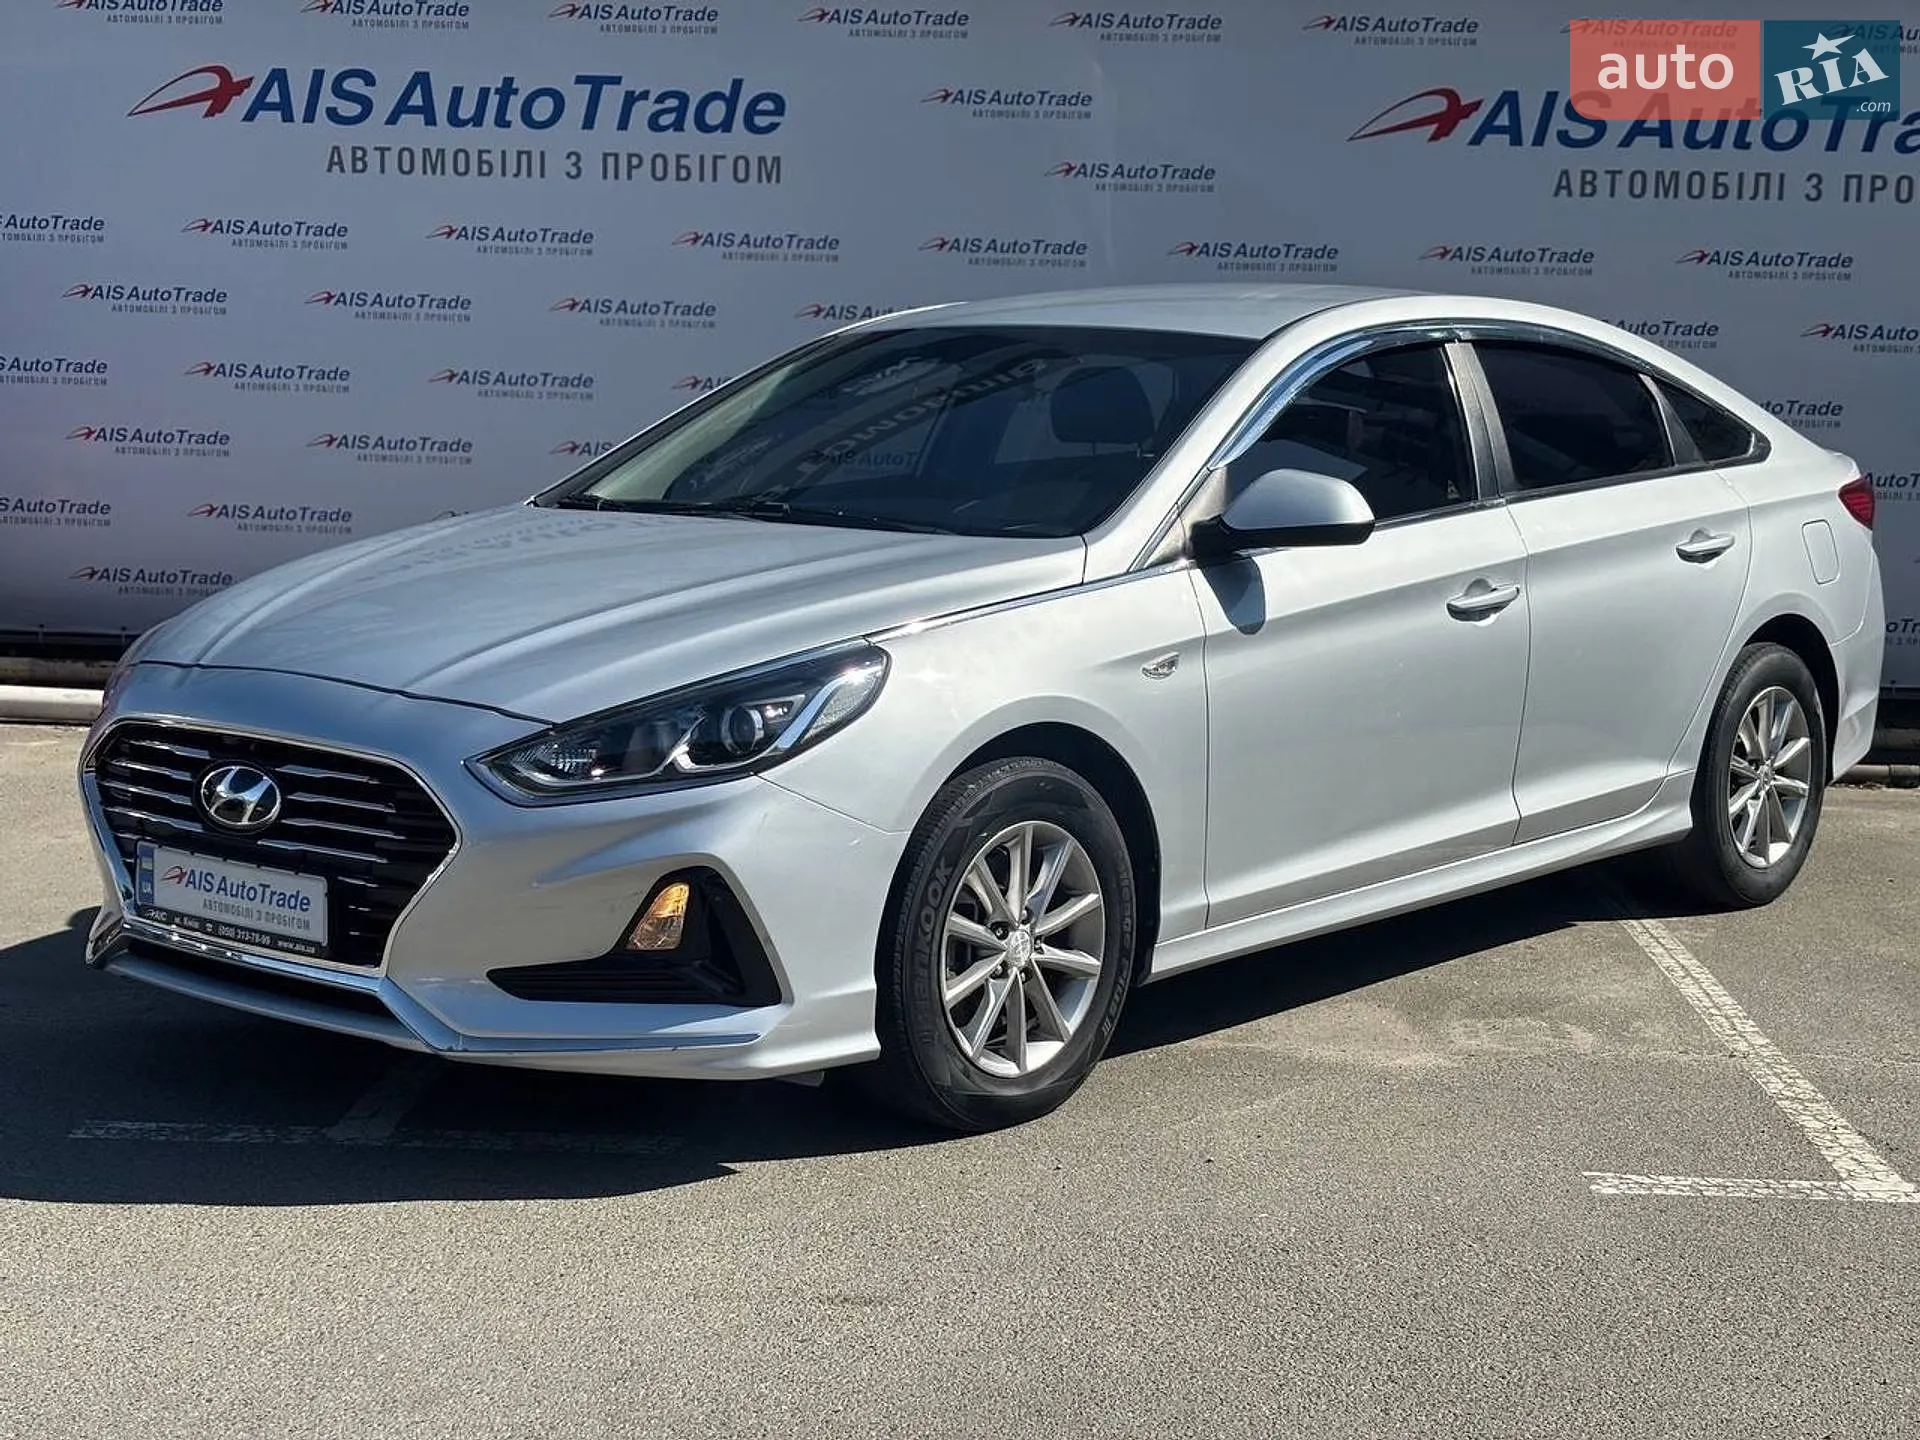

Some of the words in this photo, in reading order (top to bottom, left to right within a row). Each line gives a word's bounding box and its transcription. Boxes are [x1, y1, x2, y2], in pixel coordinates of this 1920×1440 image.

[330, 0, 365, 15] AIS
[366, 0, 470, 17] AutoTrade
[578, 4, 613, 20] AIS
[614, 5, 719, 22] AutoTrade
[827, 9, 863, 25] AIS
[864, 9, 969, 27] AutoTrade
[1078, 13, 1115, 29] AIS
[1116, 13, 1223, 30] AutoTrade
[1333, 16, 1370, 32] AIS
[1371, 16, 1479, 34] AutoTrade
[242, 68, 376, 125] AIS
[384, 71, 786, 135] AutoTrade
[950, 89, 987, 105] AIS
[987, 90, 1093, 107] AutoTrade
[1467, 90, 1612, 150] AIS
[326, 145, 546, 178] АВТОМОБІЛІ
[601, 152, 781, 184] ПРОБІГОМ
[1073, 163, 1110, 179] AIS
[1110, 164, 1216, 181] AutoTrade
[1553, 168, 1785, 201] АВТОМОБІЛІ
[4, 214, 105, 231] AutoTrade
[210, 219, 245, 235] AIS
[246, 220, 349, 238] AutoTrade
[455, 226, 490, 242] AIS
[491, 227, 594, 245] AutoTrade
[701, 232, 736, 248] AIS
[737, 233, 840, 251] AutoTrade
[947, 238, 983, 254] AIS
[983, 238, 1088, 256] AutoTrade
[1196, 242, 1232, 258] AIS
[1233, 243, 1339, 260] AutoTrade
[1449, 246, 1486, 262] AIS
[1486, 247, 1595, 264] AutoTrade
[1706, 250, 1744, 266] AIS
[1744, 251, 1854, 269] AutoTrade
[90, 285, 125, 301] AIS
[126, 286, 228, 304] AutoTrade
[333, 292, 368, 307] AIS
[369, 293, 472, 311] AutoTrade
[578, 299, 613, 314] AIS
[614, 300, 717, 317] AutoTrade
[823, 304, 858, 320] AIS
[1831, 324, 1869, 340] AIS
[7, 357, 108, 375] AutoTrade
[213, 363, 248, 379] AIS
[248, 364, 351, 382] AutoTrade
[456, 370, 491, 386] AIS
[492, 371, 594, 389] AutoTrade
[1760, 400, 1844, 417] toTrade
[93, 427, 128, 443] AIS
[129, 428, 230, 446] AutoTrade
[335, 435, 370, 450] AIS
[371, 436, 473, 453] AutoTrade
[11, 498, 111, 516] AutoTrade
[216, 504, 250, 520] AIS
[251, 505, 353, 523] AutoTrade
[97, 568, 132, 583] AIS
[185, 869, 215, 893] AIS
[216, 876, 312, 913] AutoTrade
